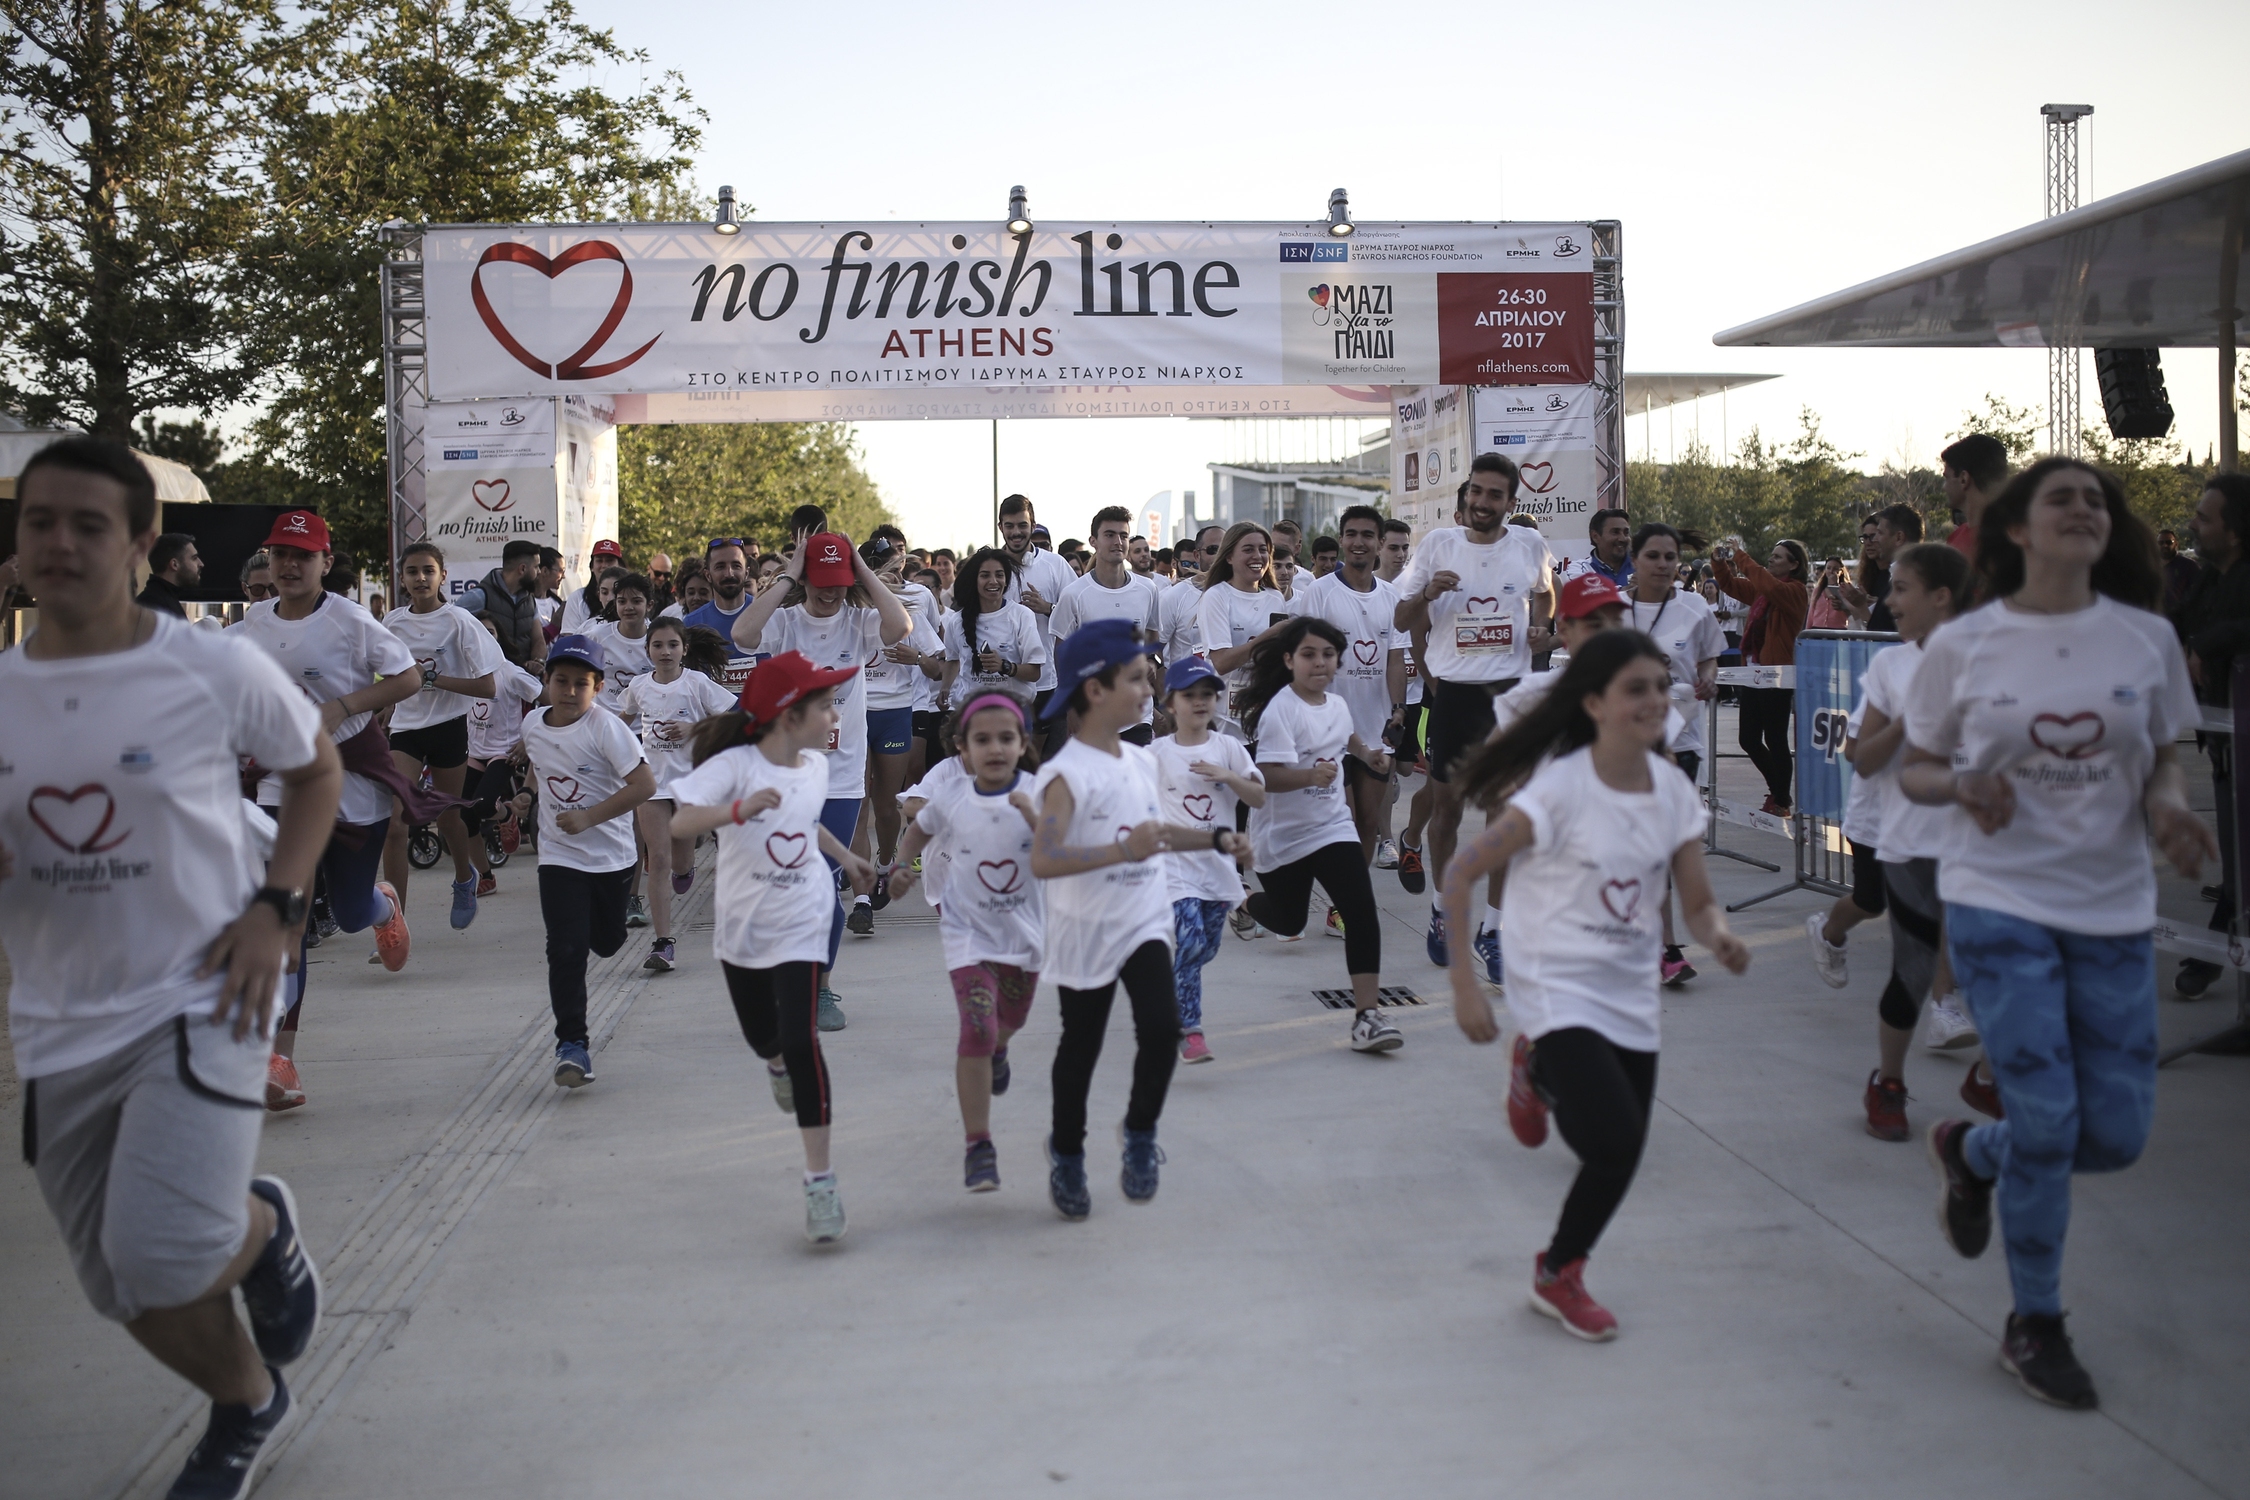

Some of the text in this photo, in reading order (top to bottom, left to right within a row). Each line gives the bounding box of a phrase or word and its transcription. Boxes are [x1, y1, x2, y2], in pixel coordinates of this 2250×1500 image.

[1317, 247, 1344, 258] SNF
[1351, 244, 1382, 252] ΙΔΡΥΜΑ
[691, 230, 1241, 344] no finish line
[1333, 285, 1393, 314] ΜΑΖΙ
[1497, 288, 1547, 305] 26-30
[1474, 310, 1567, 326] ΑΠΡΙΛΙΟΥ
[880, 327, 1055, 359] ATHENS
[1334, 329, 1394, 359] ΠΑΙΔΙ
[1501, 332, 1547, 348] 2017
[1324, 363, 1406, 375] Together for Children
[1477, 359, 1570, 373] nflathens.com
[687, 366, 1244, 386] ΣΤΟ ΚΕΝΤΡΟ ΠΟΛΙΤΙΣΜΟΥ ΙΔΡΥΜΑ ΣΤΑΥΡΟΣ ΝΙΑΡΧΟΣ
[1556, 497, 1587, 513] line
[438, 515, 546, 539] no finish line
[476, 535, 509, 543] ATHENS
[1481, 628, 1510, 641] 4436
[1955, 754, 1969, 765] lin
